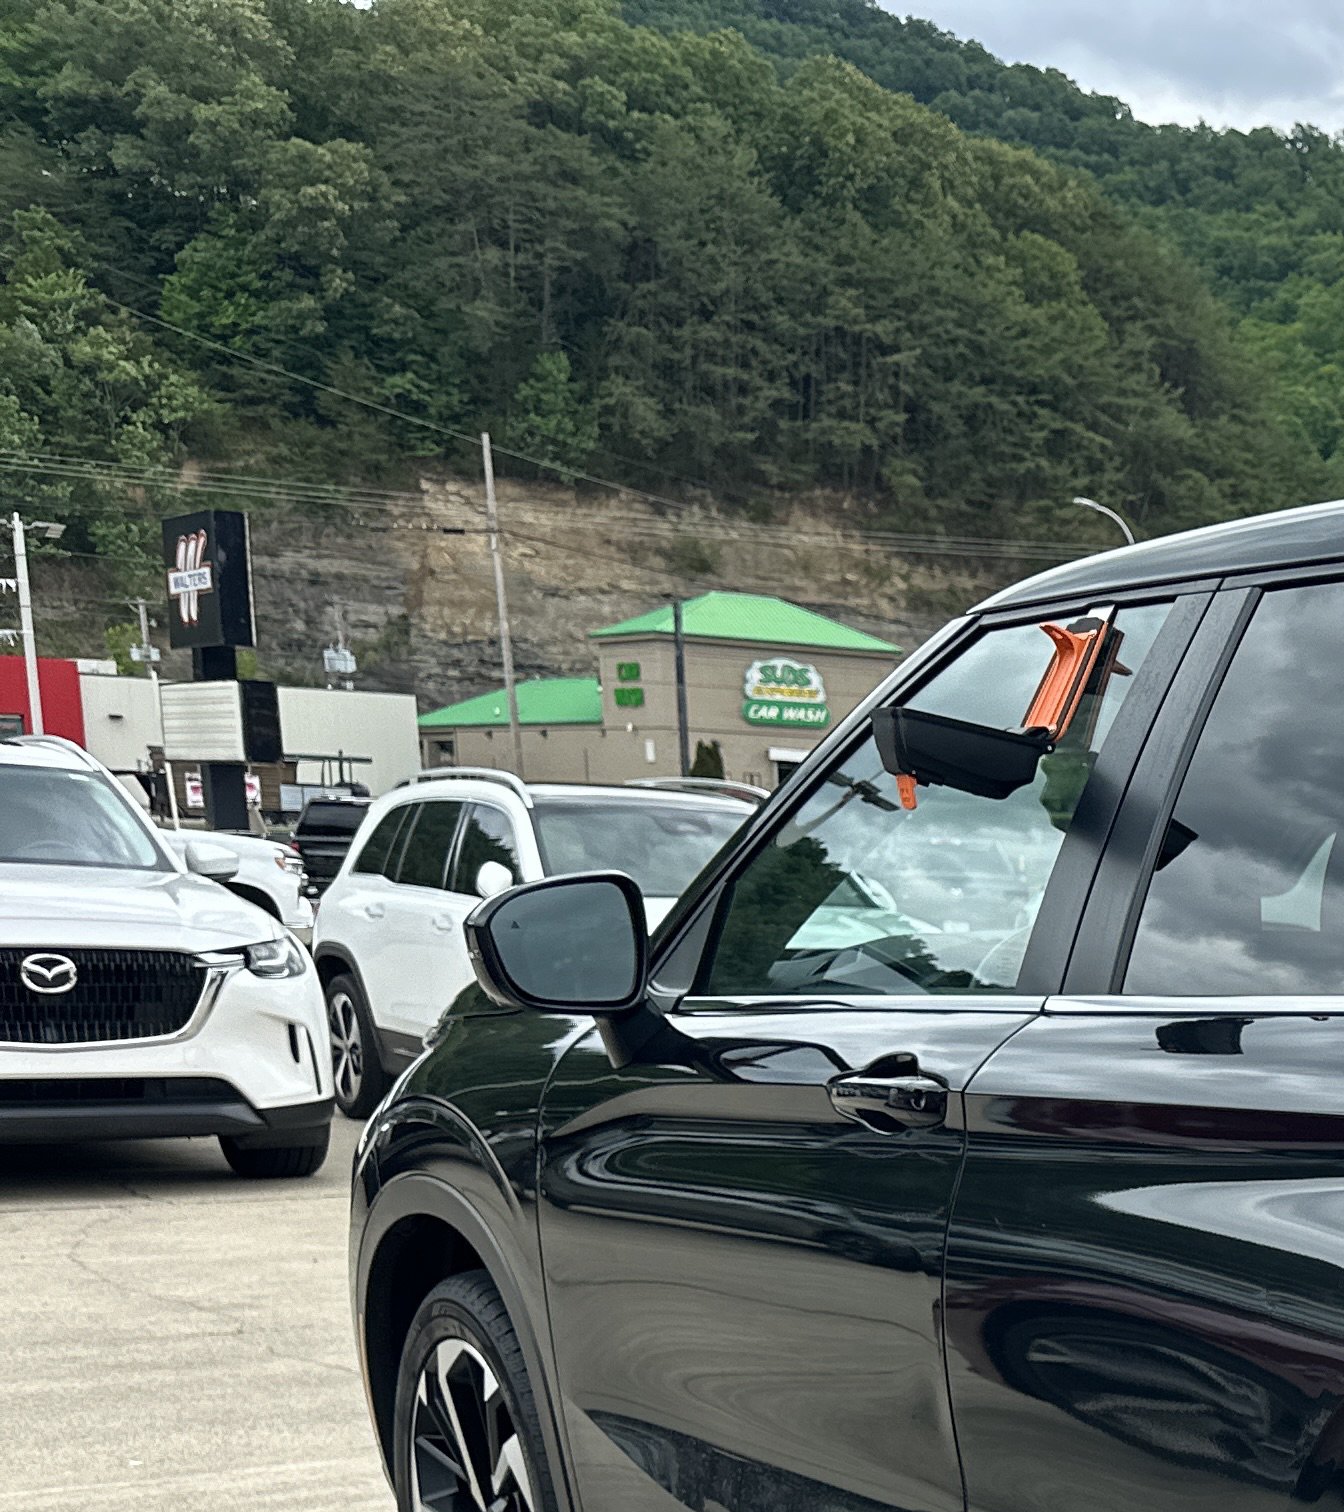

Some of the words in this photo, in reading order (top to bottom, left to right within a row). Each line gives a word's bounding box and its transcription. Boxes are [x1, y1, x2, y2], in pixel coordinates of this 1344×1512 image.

[759, 665, 811, 686] SUDS
[750, 705, 778, 720] CAR
[783, 707, 826, 723] WASH
